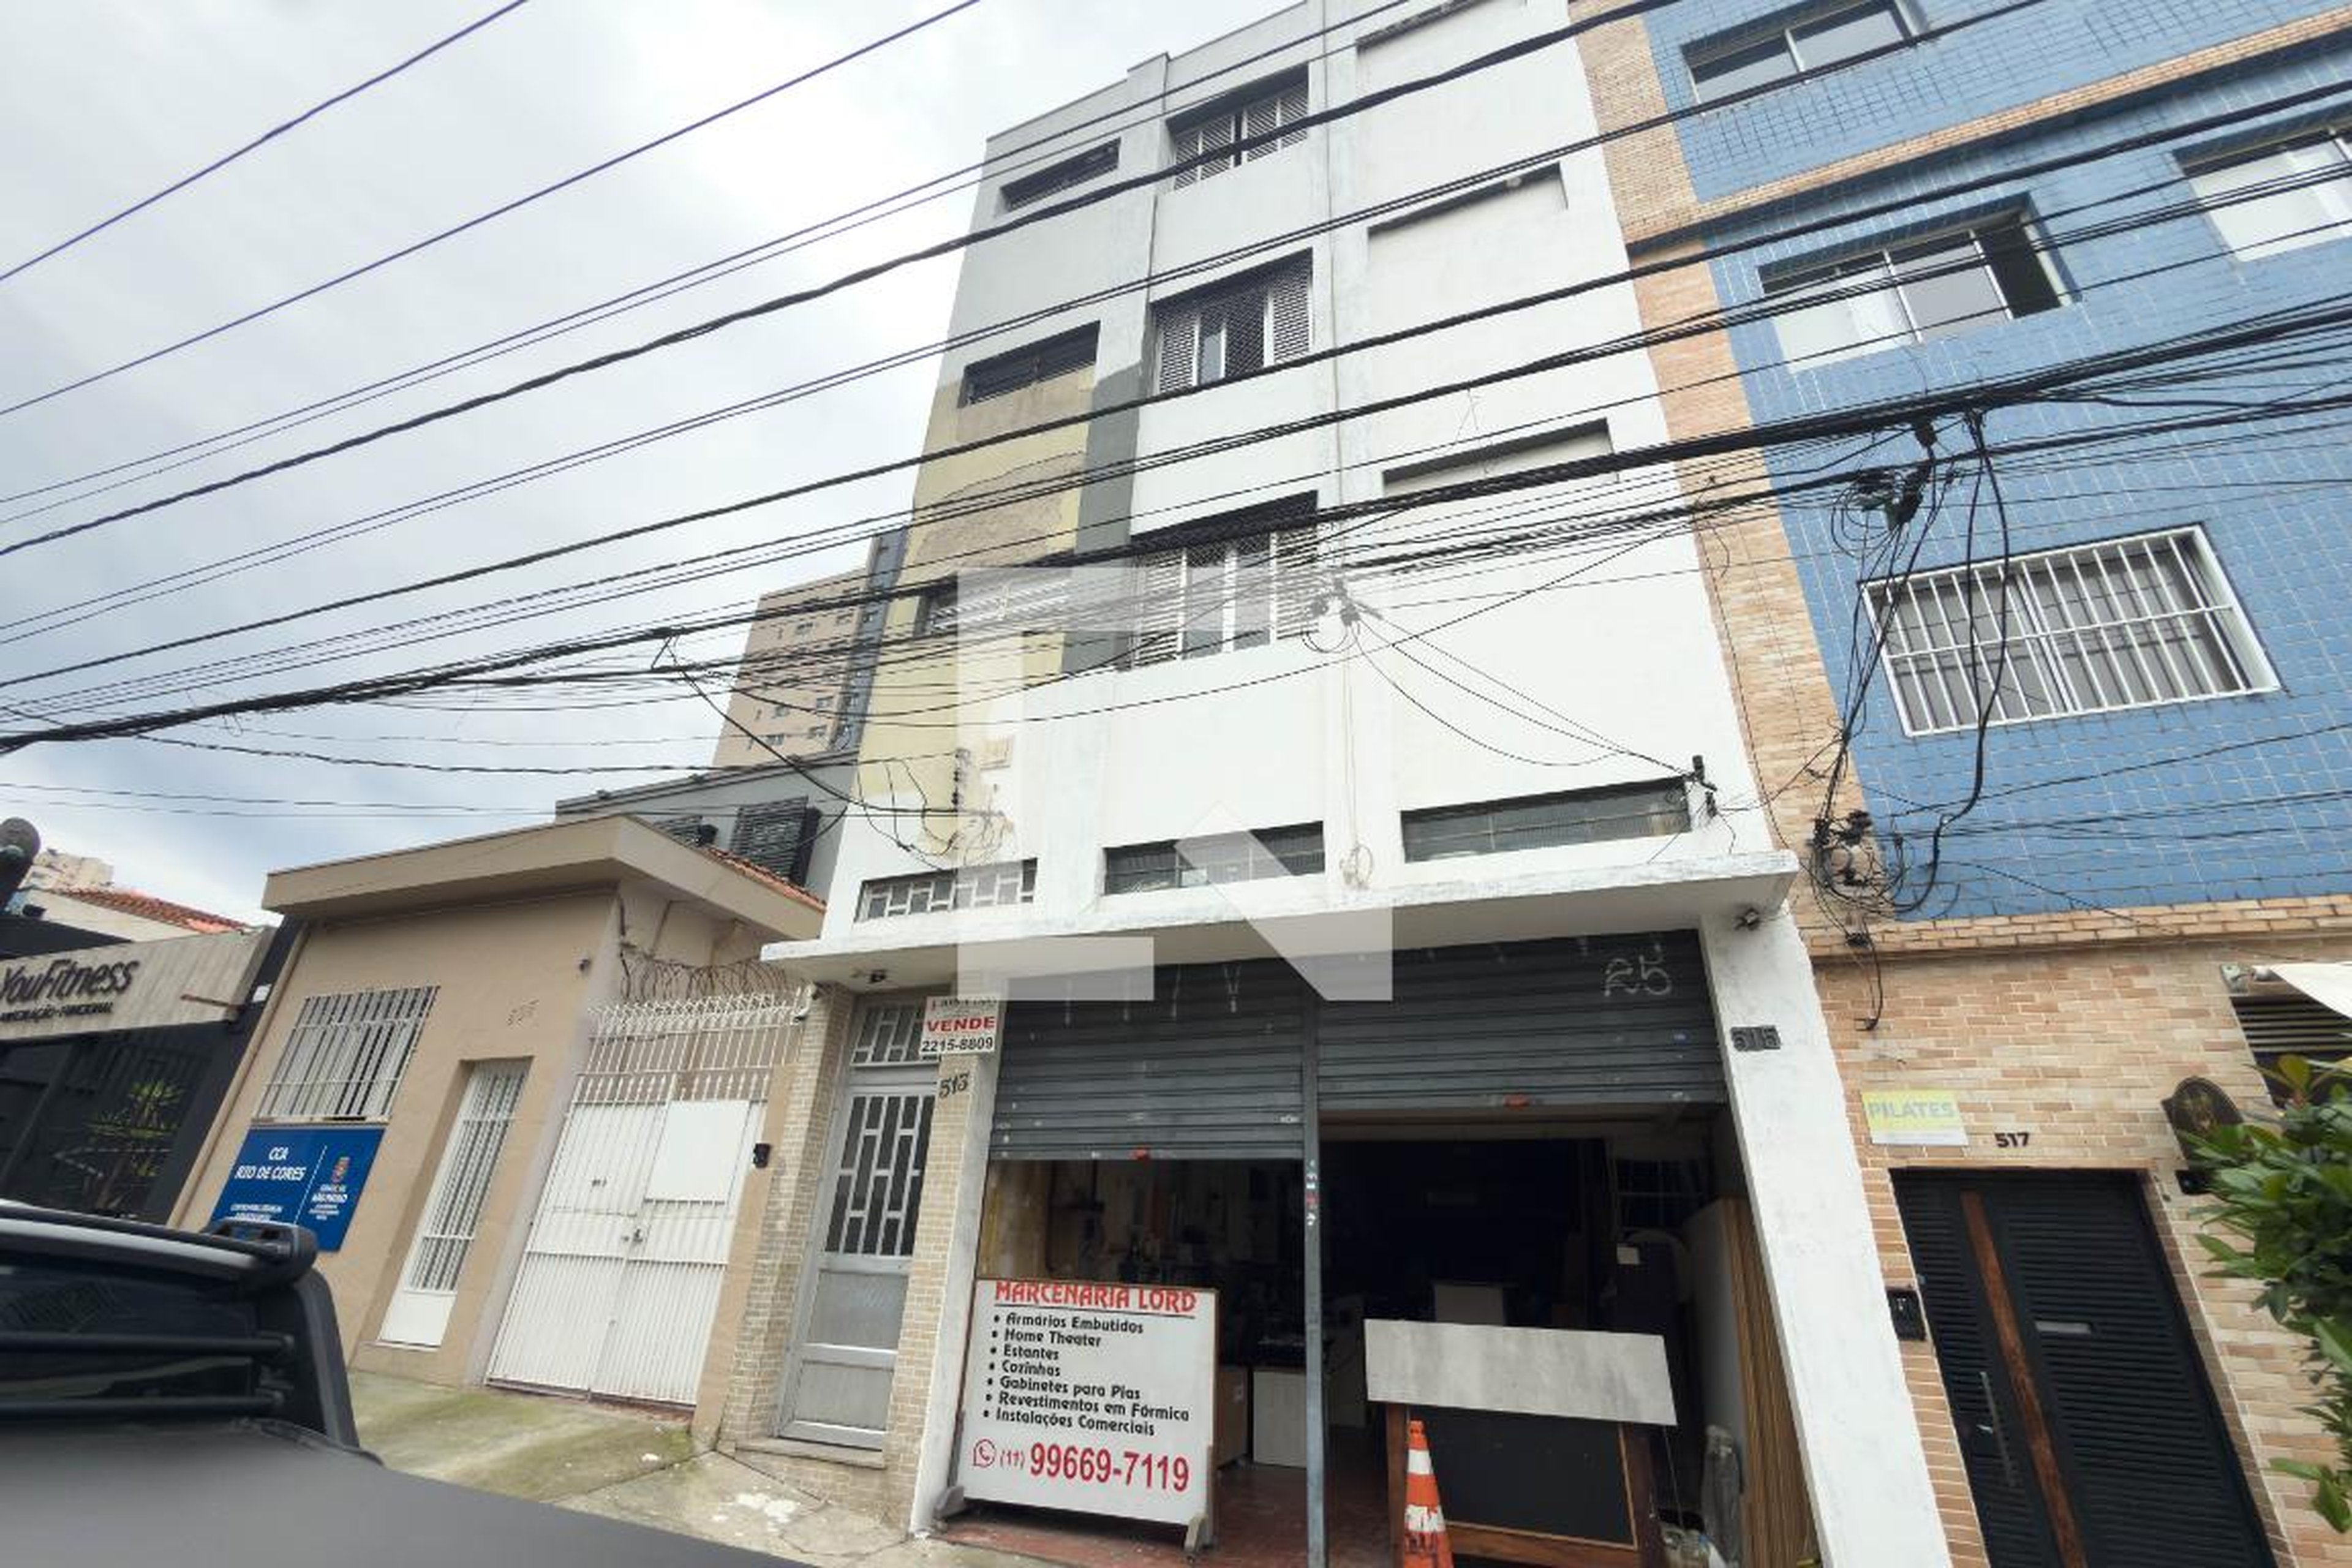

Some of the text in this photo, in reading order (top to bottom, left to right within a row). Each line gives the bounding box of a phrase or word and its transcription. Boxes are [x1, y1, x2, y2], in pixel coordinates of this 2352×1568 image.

[0, 959, 140, 1005] YouFitness
[927, 1016, 995, 1032] VENDE
[921, 1036, 993, 1052] 2215-8809
[1869, 1102, 1954, 1118] PILATES
[1994, 1133, 2030, 1148] 517
[268, 1146, 289, 1160] CCA
[256, 1165, 272, 1180] DE
[271, 1166, 307, 1182] CORES
[995, 1281, 1197, 1313] MARCENARIA LORD
[1006, 1312, 1144, 1334] Armários Embutidos
[1004, 1329, 1102, 1347] Home Theater
[1003, 1344, 1060, 1360] Estantes
[1001, 1360, 1061, 1377] Cozinhas
[1000, 1376, 1140, 1400] Gabinetes para Pias
[998, 1391, 1189, 1422] Revestimentos em Fórmica
[995, 1408, 1155, 1436] Instalações Comerciais
[1000, 1442, 1189, 1493] (11) 99669-7119
